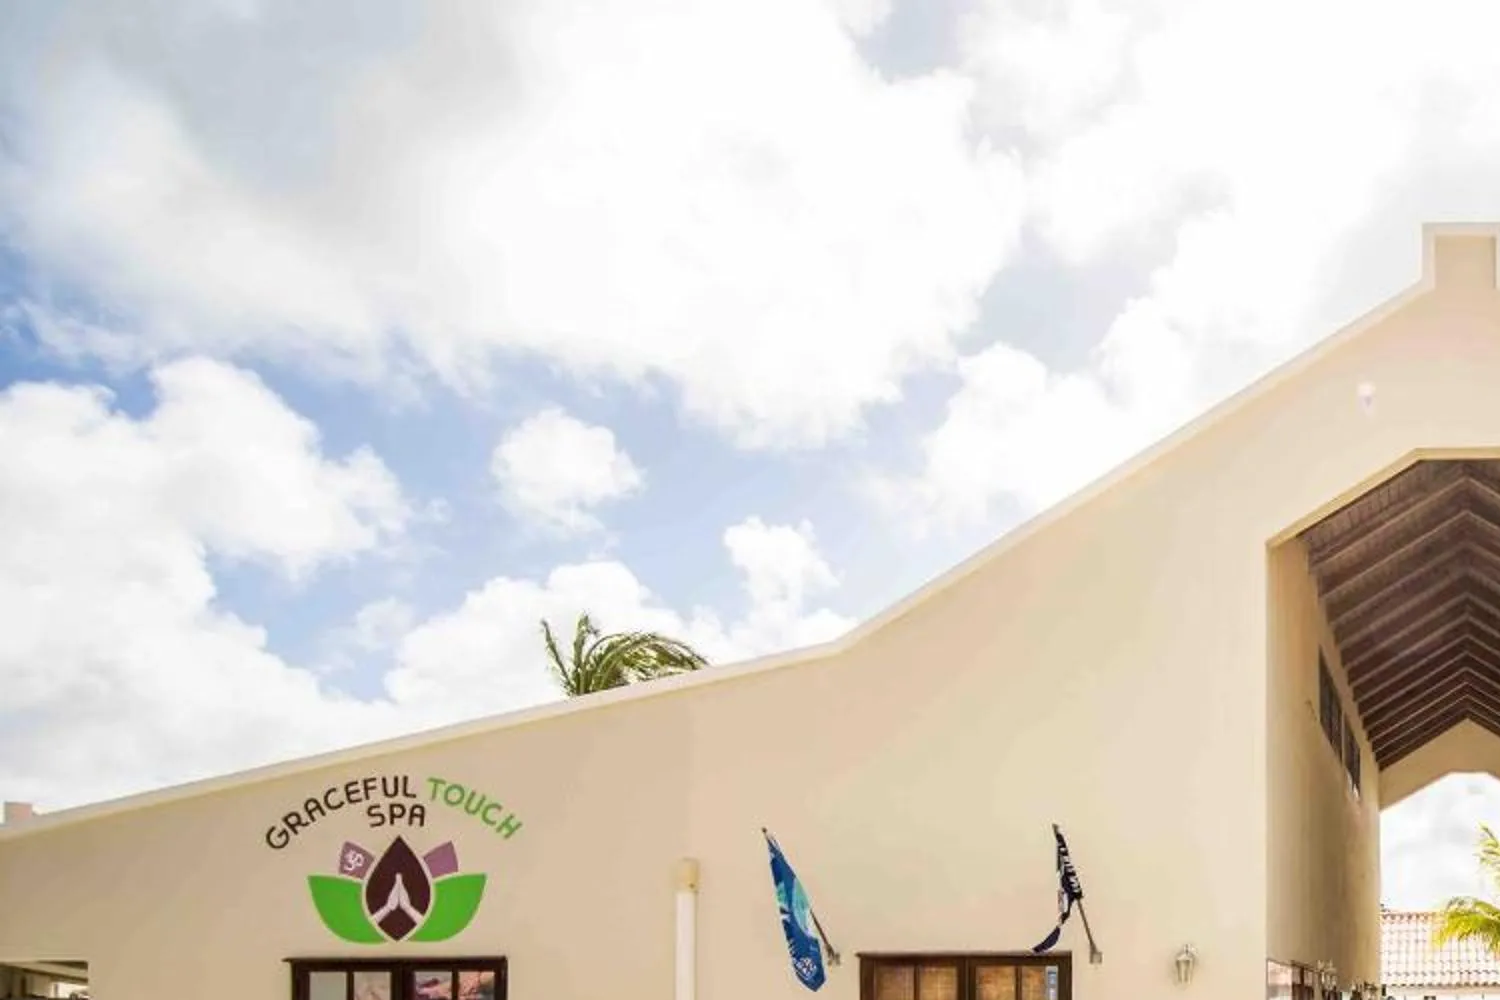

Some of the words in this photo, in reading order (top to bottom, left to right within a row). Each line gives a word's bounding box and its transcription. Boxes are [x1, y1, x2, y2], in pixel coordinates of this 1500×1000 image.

[265, 775, 417, 850] GRACEFUL
[427, 777, 523, 840] TOUCH
[367, 803, 426, 828] SPA
